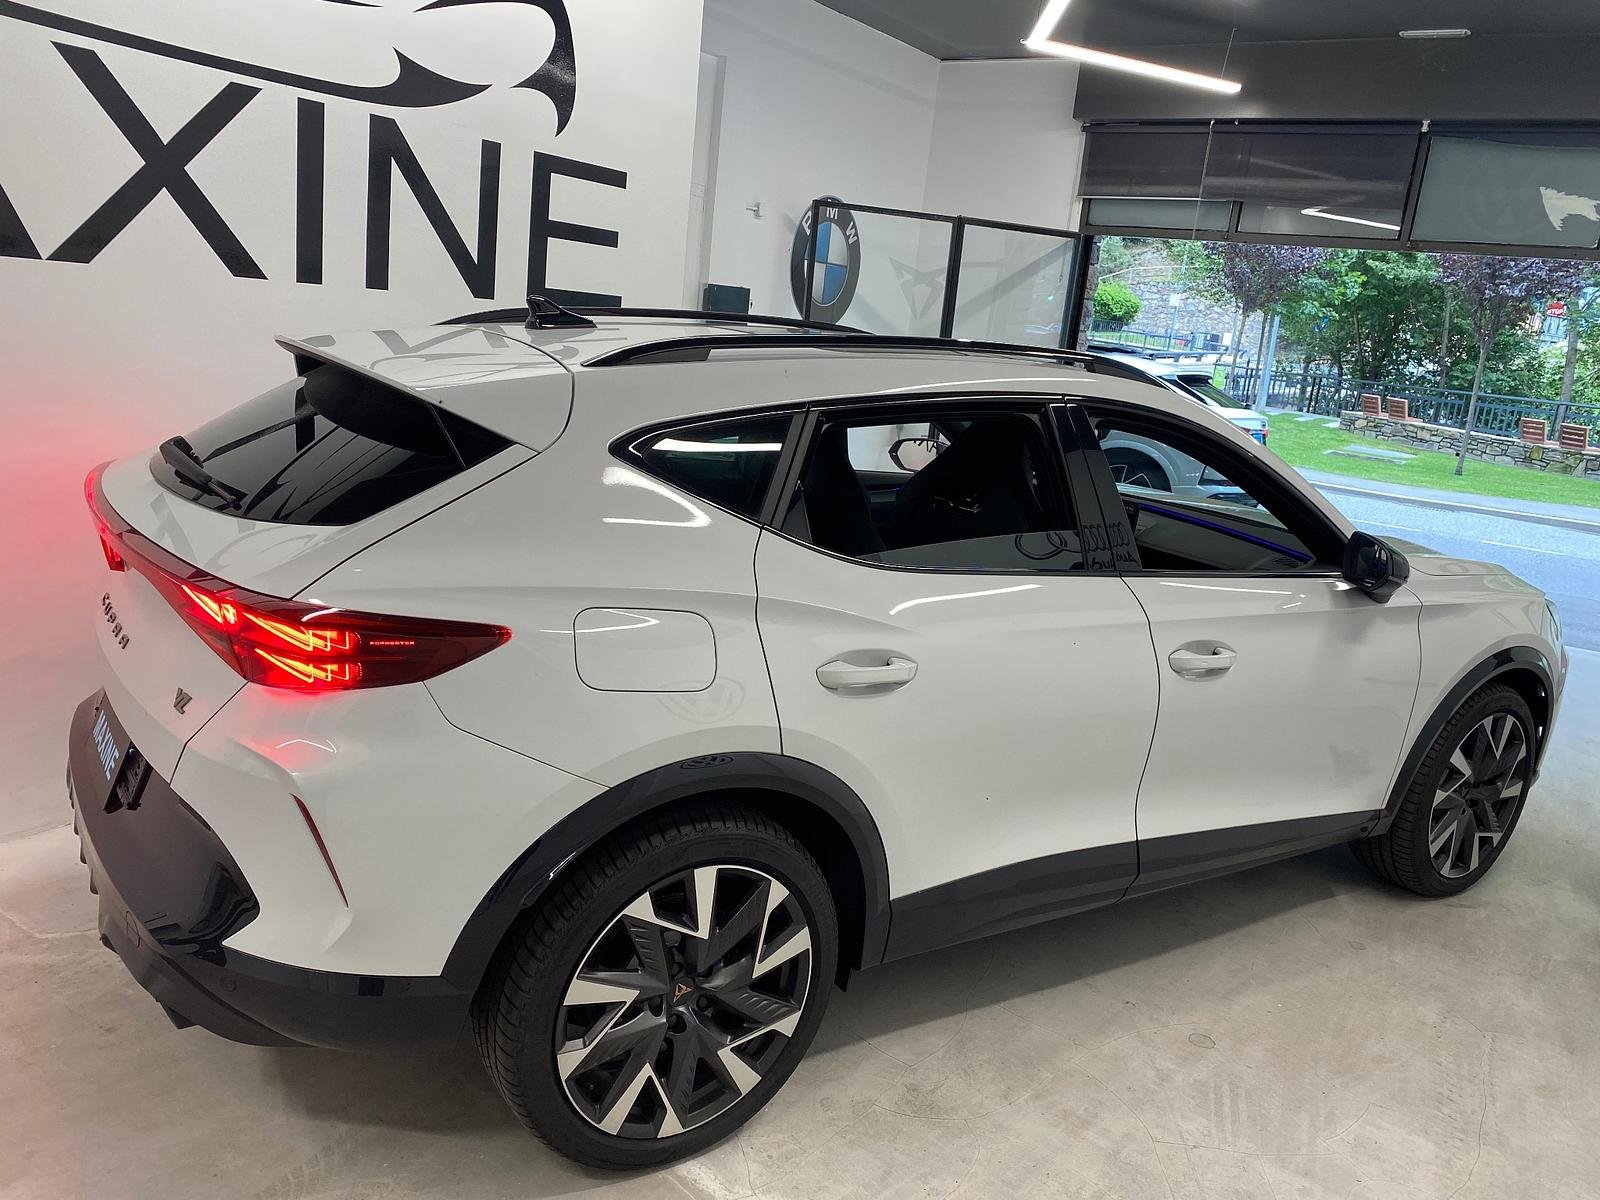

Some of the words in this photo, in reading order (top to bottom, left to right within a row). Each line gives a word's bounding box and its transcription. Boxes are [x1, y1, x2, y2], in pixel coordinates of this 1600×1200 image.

[0, 40, 627, 308] XINE
[802, 198, 858, 245] BMW
[102, 592, 130, 650] CUPRA
[173, 687, 193, 715] VZ
[92, 709, 120, 781] MAXINE
